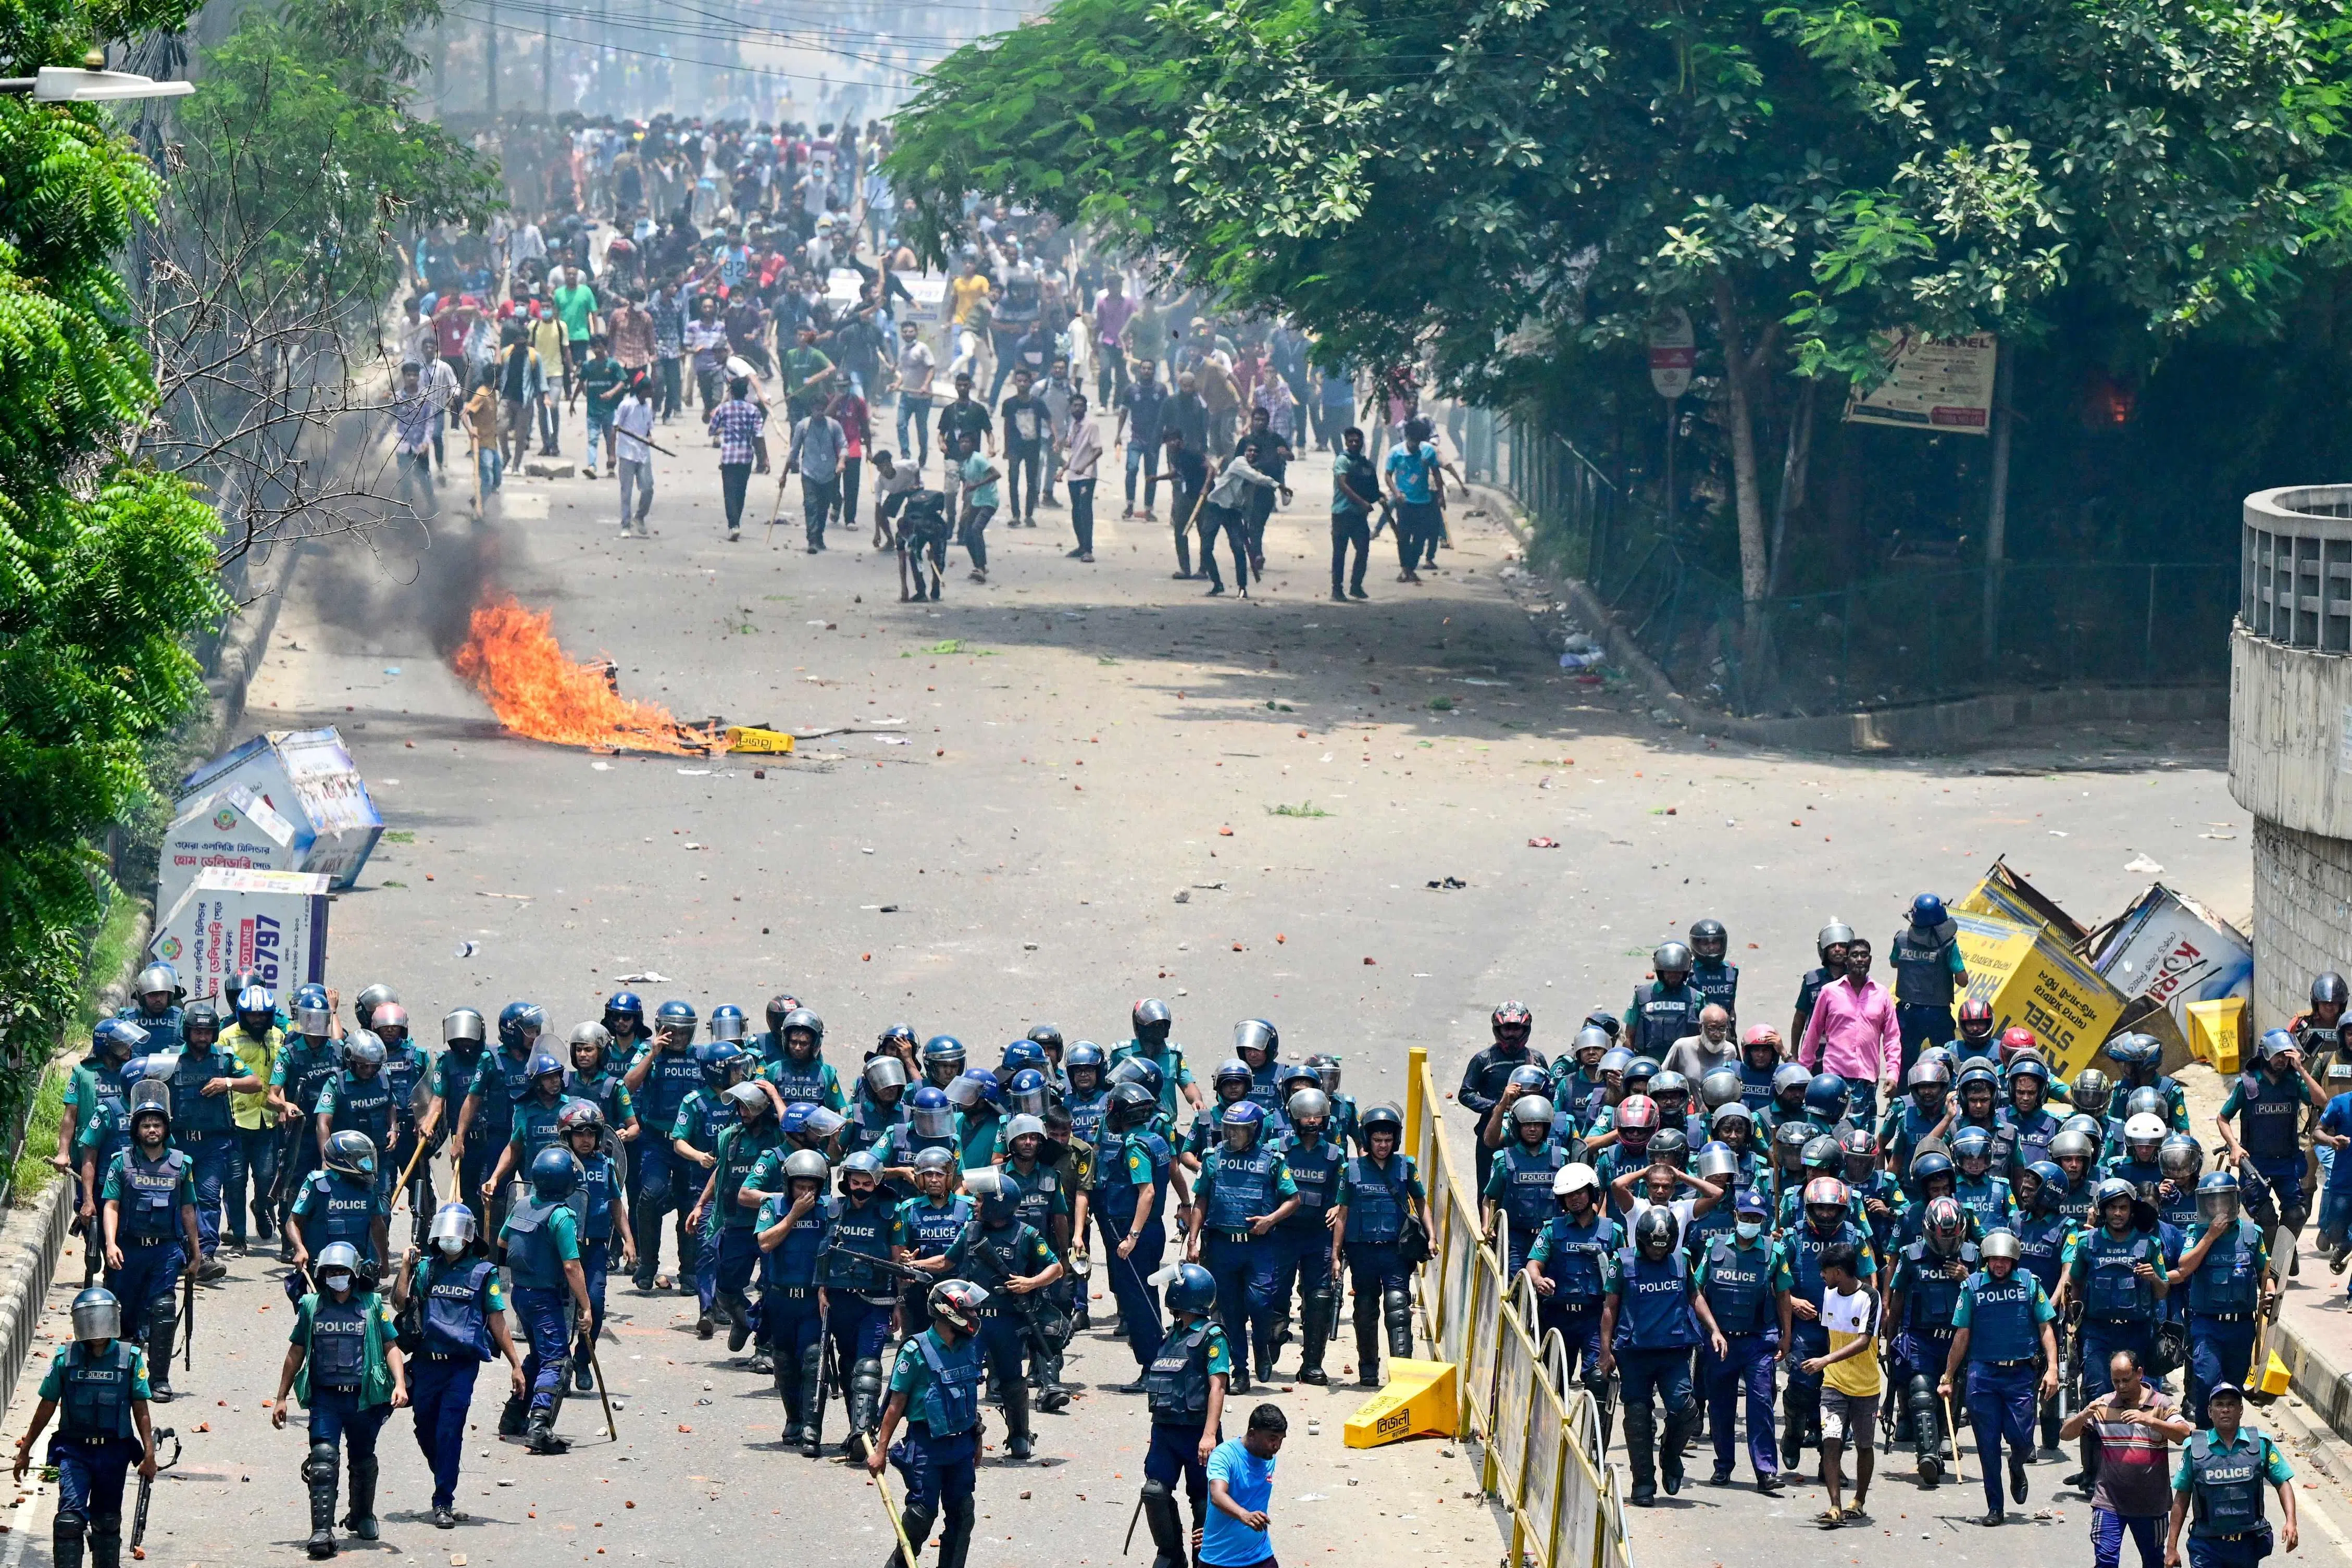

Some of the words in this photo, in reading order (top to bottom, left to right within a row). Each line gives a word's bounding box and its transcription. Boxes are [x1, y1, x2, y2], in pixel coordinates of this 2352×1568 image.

[724, 262, 745, 277] 92
[1901, 950, 1936, 960] POLICE
[1702, 984, 1731, 993] POLICE
[1647, 1002, 1685, 1012] POLICE
[2024, 1000, 2075, 1051] STEEL
[707, 1065, 723, 1074] POLICE
[95, 1084, 122, 1093] POLI
[785, 1088, 817, 1097] POLICE
[351, 1099, 388, 1109] POLICE
[1219, 1159, 1264, 1172] POLICE
[135, 1176, 175, 1186] POLICE
[328, 1200, 367, 1210] POLICE
[1974, 1202, 1994, 1212] LICE
[2059, 1205, 2088, 1213] OLICE
[836, 1225, 874, 1237] POLICE
[920, 1229, 955, 1238] POLICE
[2099, 1256, 2133, 1267] POLICE
[1716, 1270, 1756, 1282] POLICE
[432, 1285, 469, 1296] POLICE
[1640, 1281, 1678, 1293] POLICE
[1978, 1288, 2026, 1302] POLICE
[316, 1322, 363, 1333] POLICE
[1154, 1359, 1185, 1367] POLICE
[1377, 1409, 1412, 1435] বিজলী
[2206, 1467, 2250, 1479] POLICE
